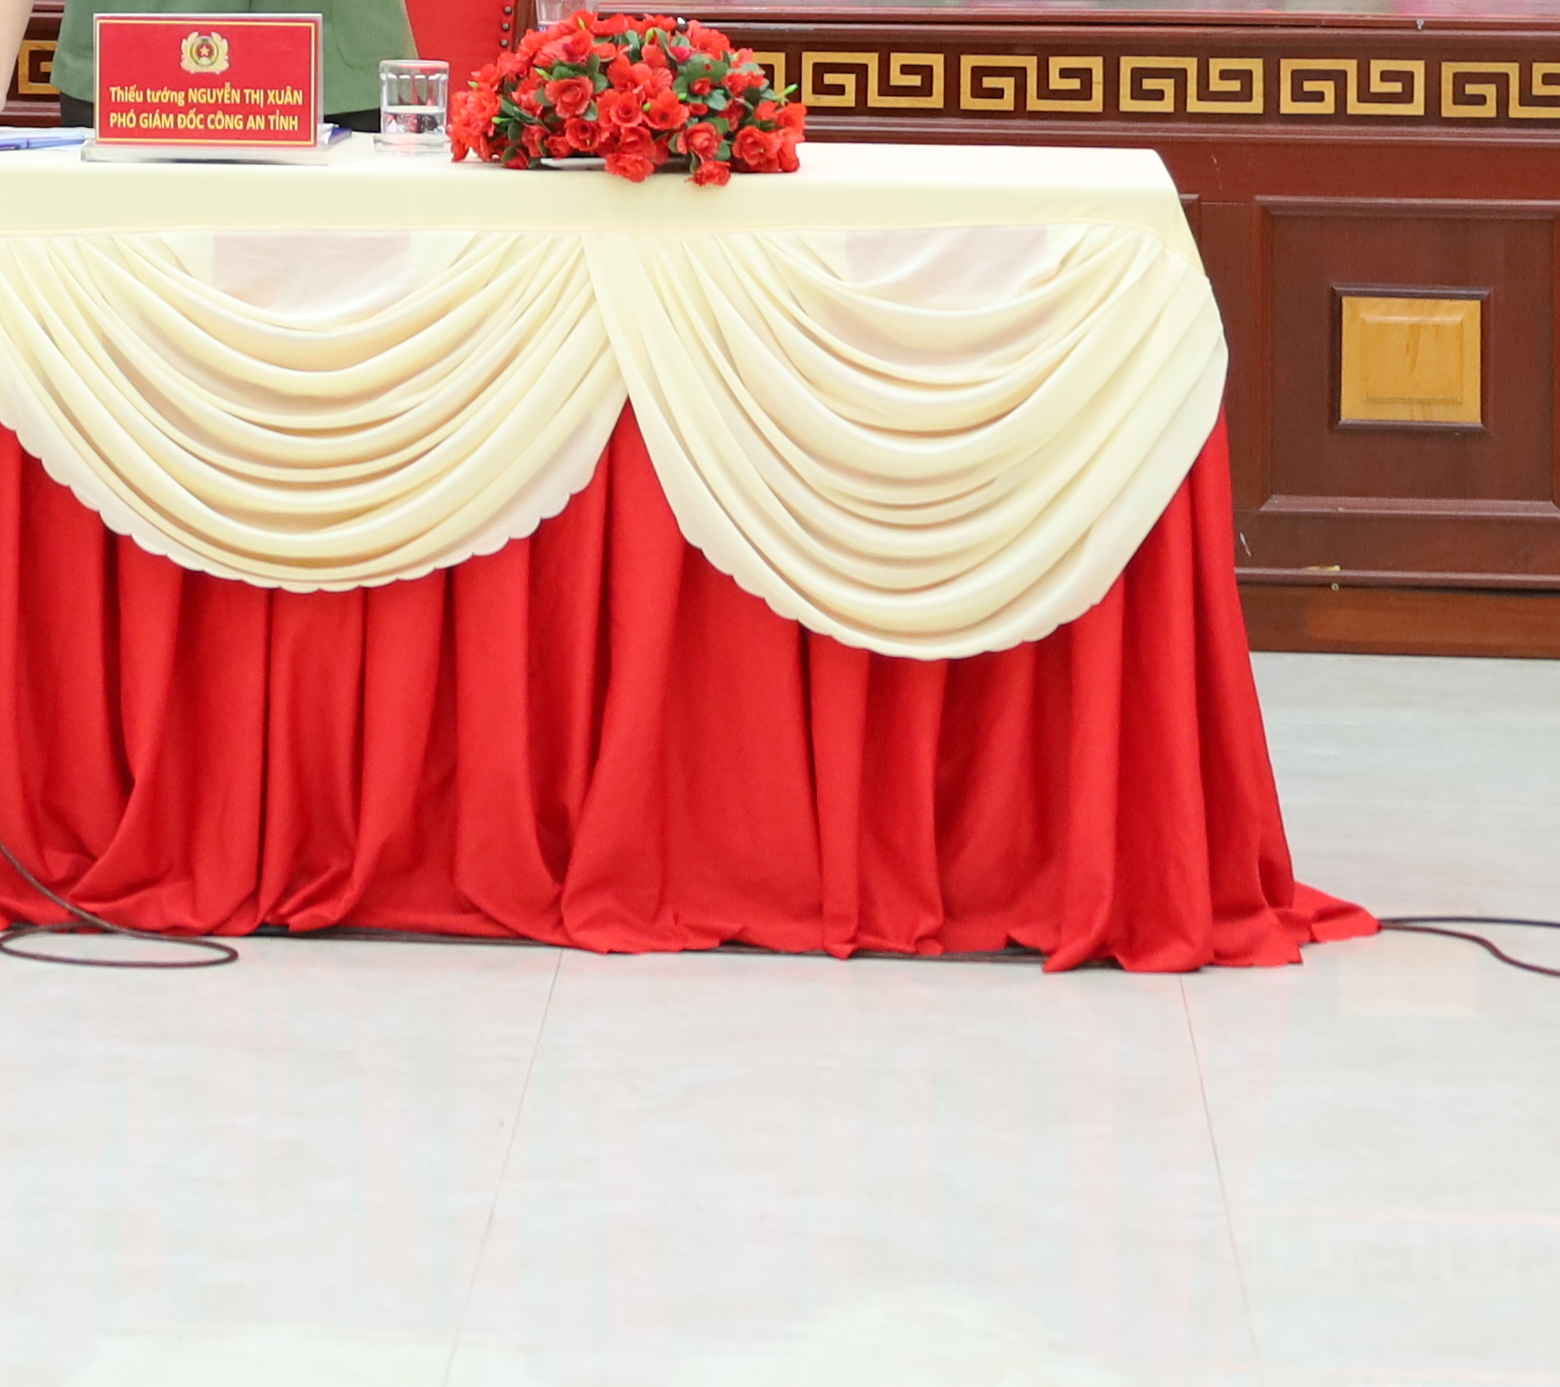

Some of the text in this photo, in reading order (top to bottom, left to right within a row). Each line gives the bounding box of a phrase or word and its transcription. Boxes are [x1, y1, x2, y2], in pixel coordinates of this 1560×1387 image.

[109, 82, 303, 107] Thiếu tướng NGUYỄN THỊ XUÂN
[109, 108, 298, 131] PHÓ GIÁM ĐỐC CÔNG AN TỈNH
